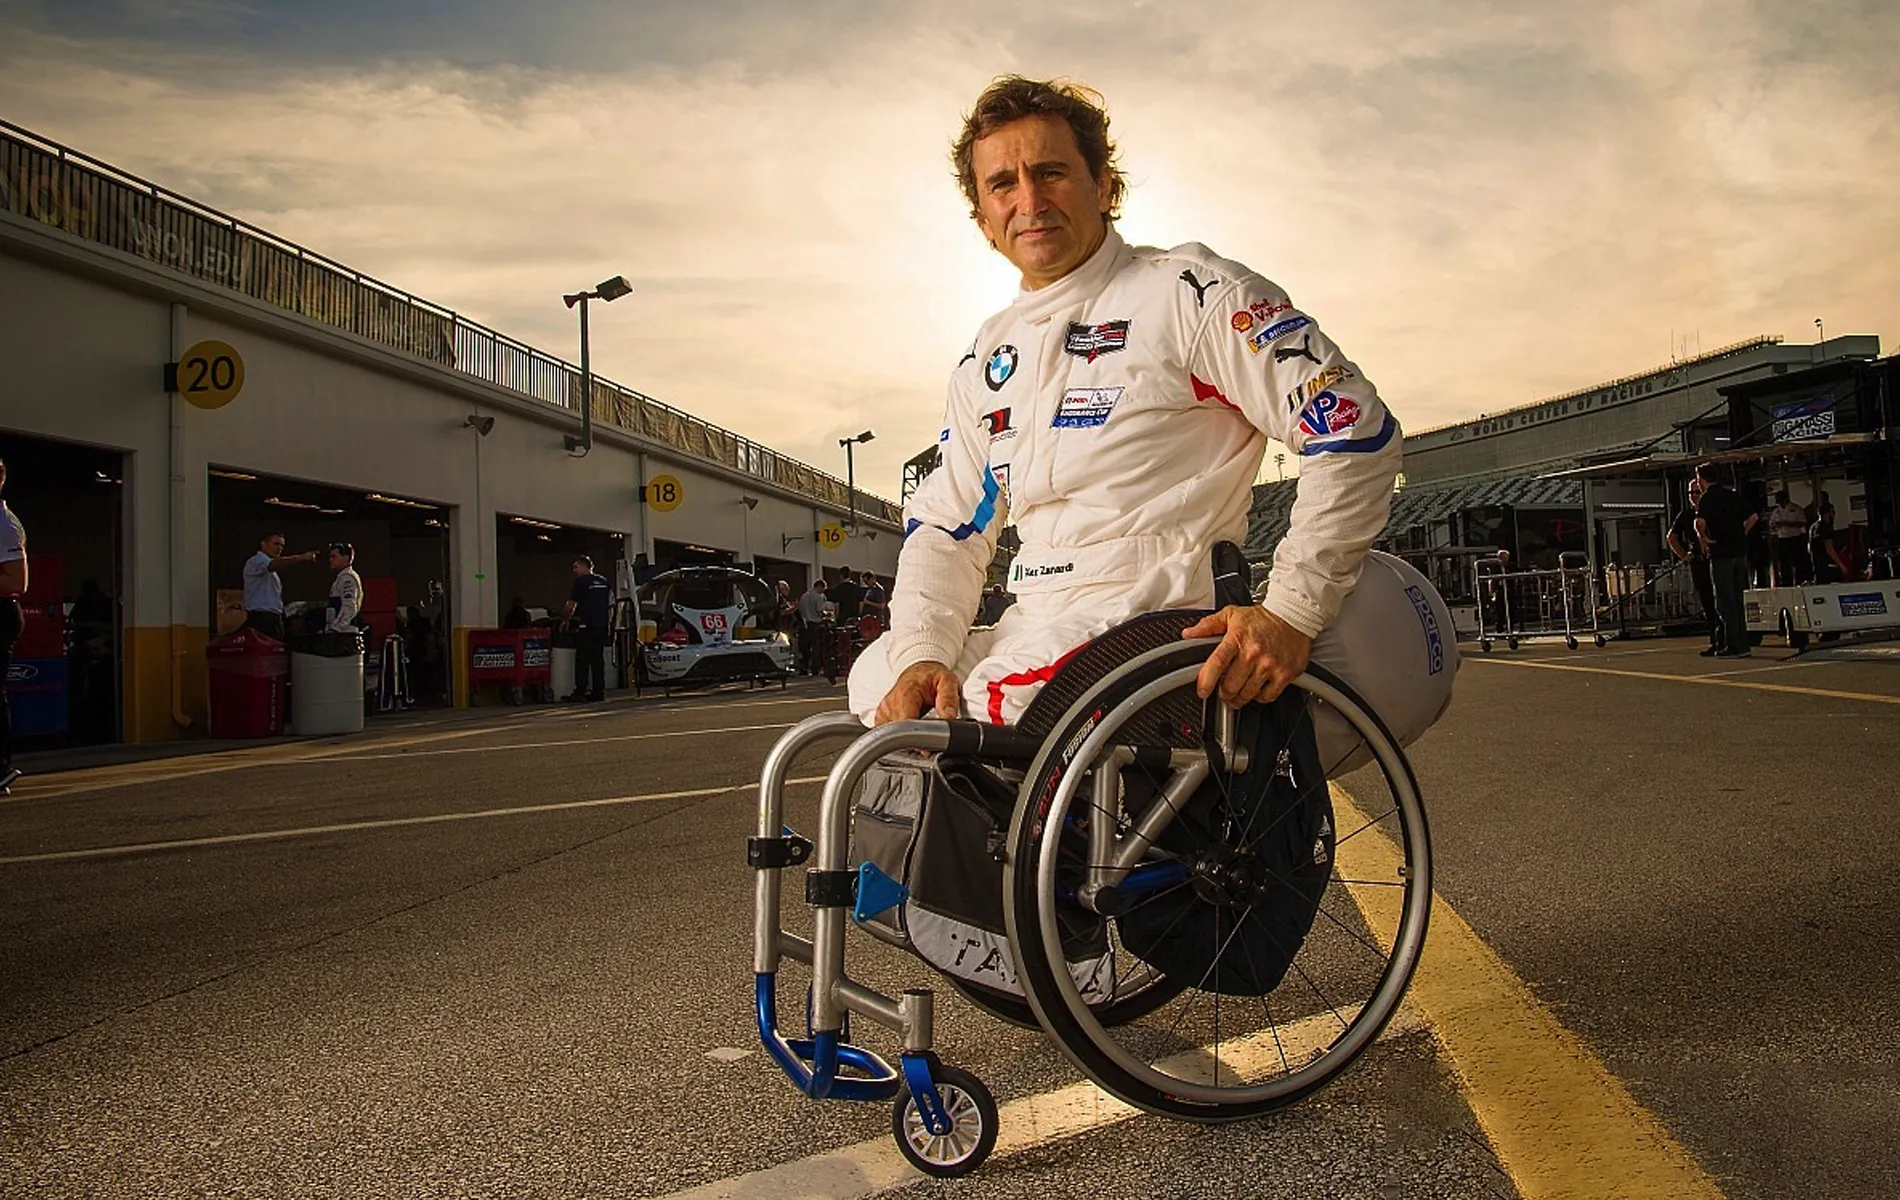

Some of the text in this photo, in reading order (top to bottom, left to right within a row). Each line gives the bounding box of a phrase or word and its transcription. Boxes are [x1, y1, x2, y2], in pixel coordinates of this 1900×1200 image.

[186, 355, 236, 393] 20
[1472, 384, 1653, 437] WORLD CENTER OF RACING
[653, 483, 676, 503] 18
[824, 529, 841, 543] 16
[705, 615, 724, 629] 66
